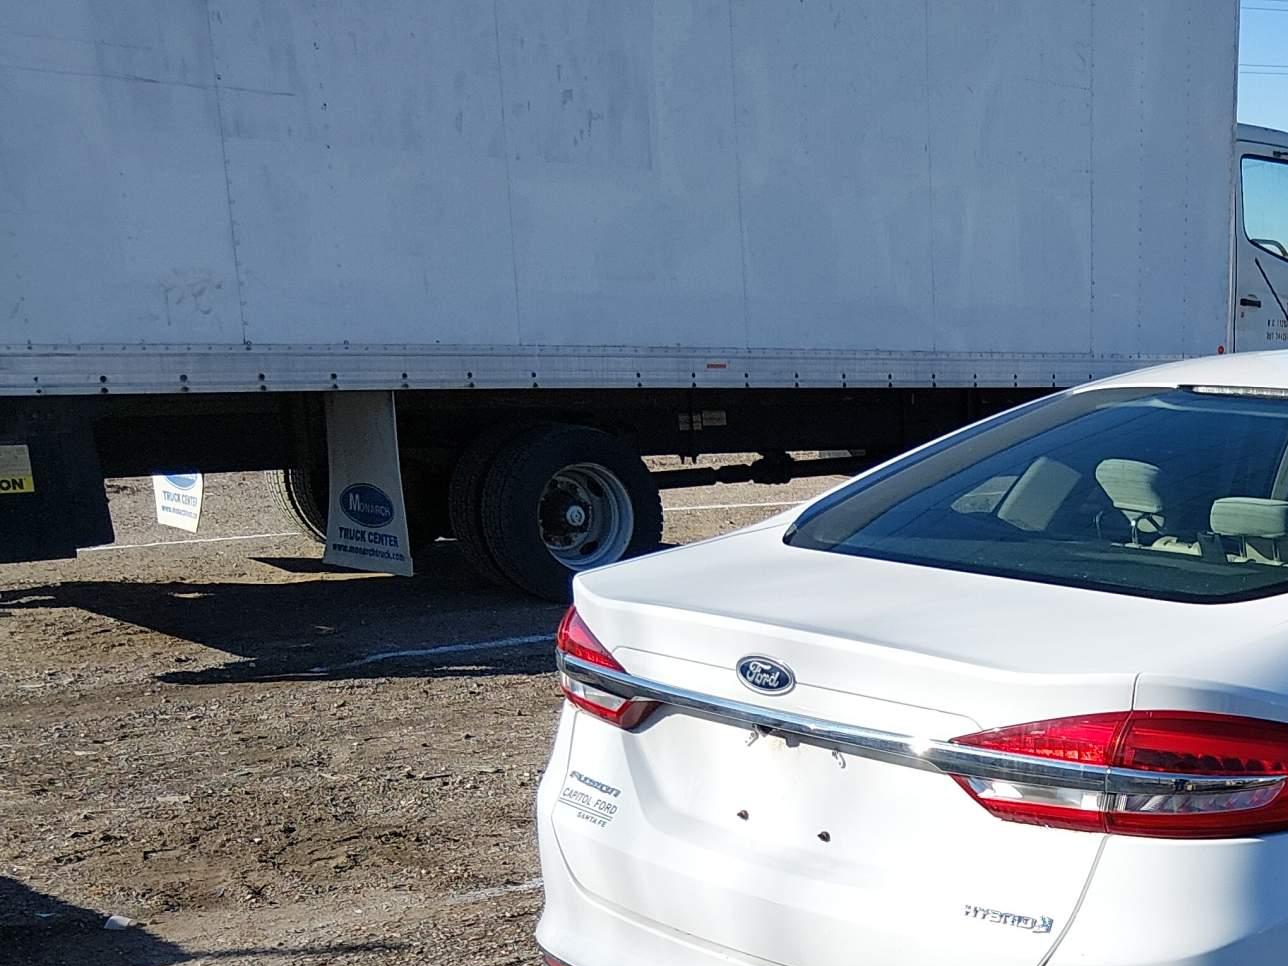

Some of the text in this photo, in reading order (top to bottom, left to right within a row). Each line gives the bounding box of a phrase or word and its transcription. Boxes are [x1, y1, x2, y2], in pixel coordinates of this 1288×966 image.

[338, 526, 399, 548] TRUCK CENTER
[332, 543, 406, 562] www.monarchtruck.com
[746, 661, 780, 689] Ford
[562, 787, 618, 815] CAPITOL FORD
[577, 811, 608, 828] SANTA FE
